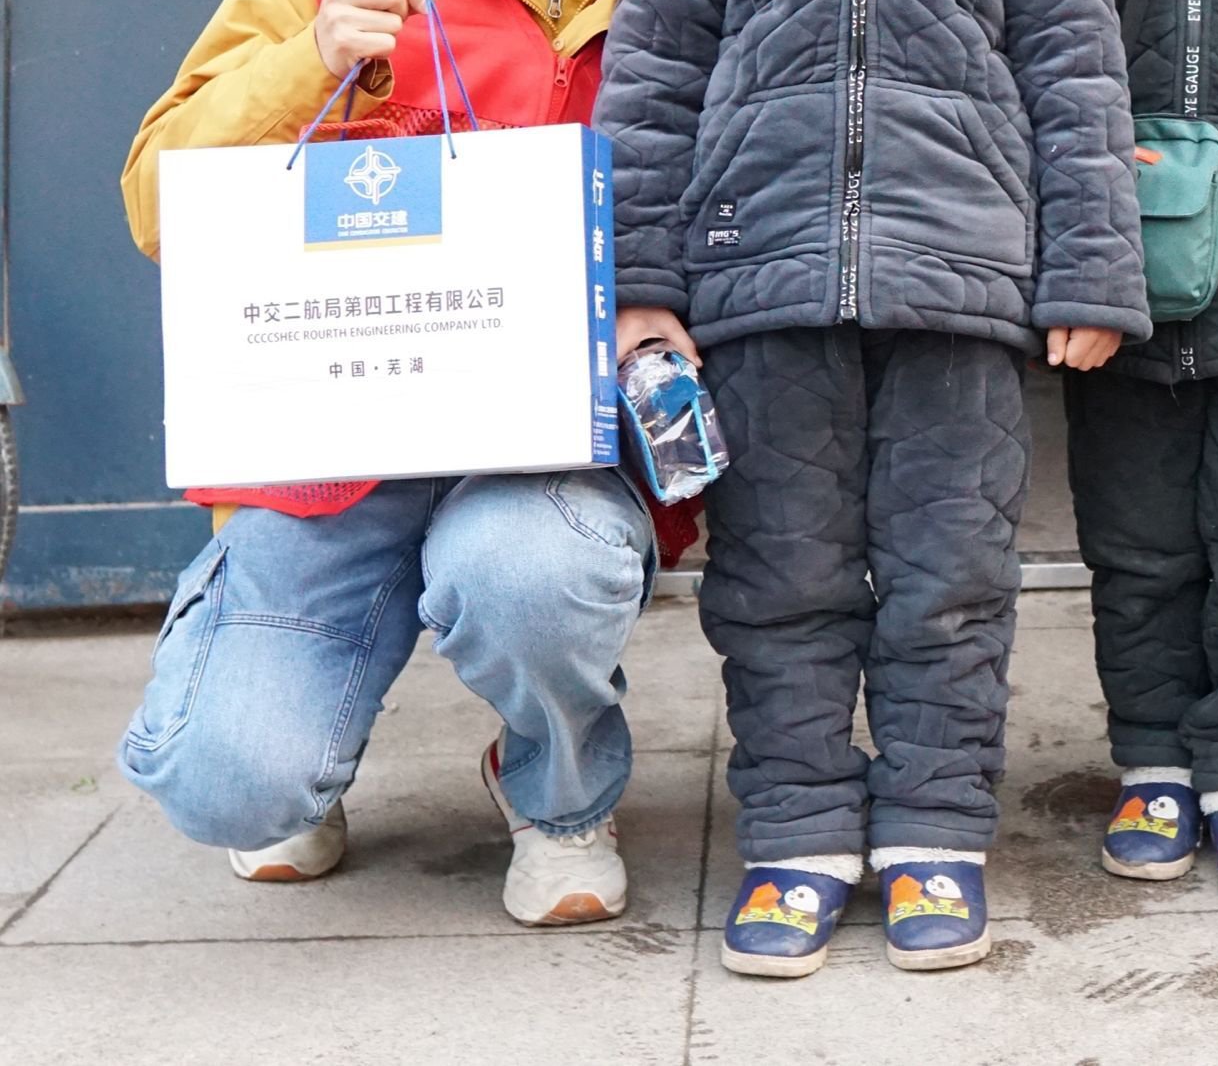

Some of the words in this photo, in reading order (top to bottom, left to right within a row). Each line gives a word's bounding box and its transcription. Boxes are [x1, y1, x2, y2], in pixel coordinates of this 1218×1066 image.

[1188, 0, 1201, 22] EYE
[1185, 45, 1200, 94] GAUGE
[337, 210, 408, 229] 中国交建
[244, 287, 504, 324] 中交二航局第四工程有限公司
[247, 331, 300, 344] CCCCSHEC
[350, 323, 421, 338] ENGINEERING
[424, 319, 480, 333] COMPANY
[482, 318, 504, 329] LTD.
